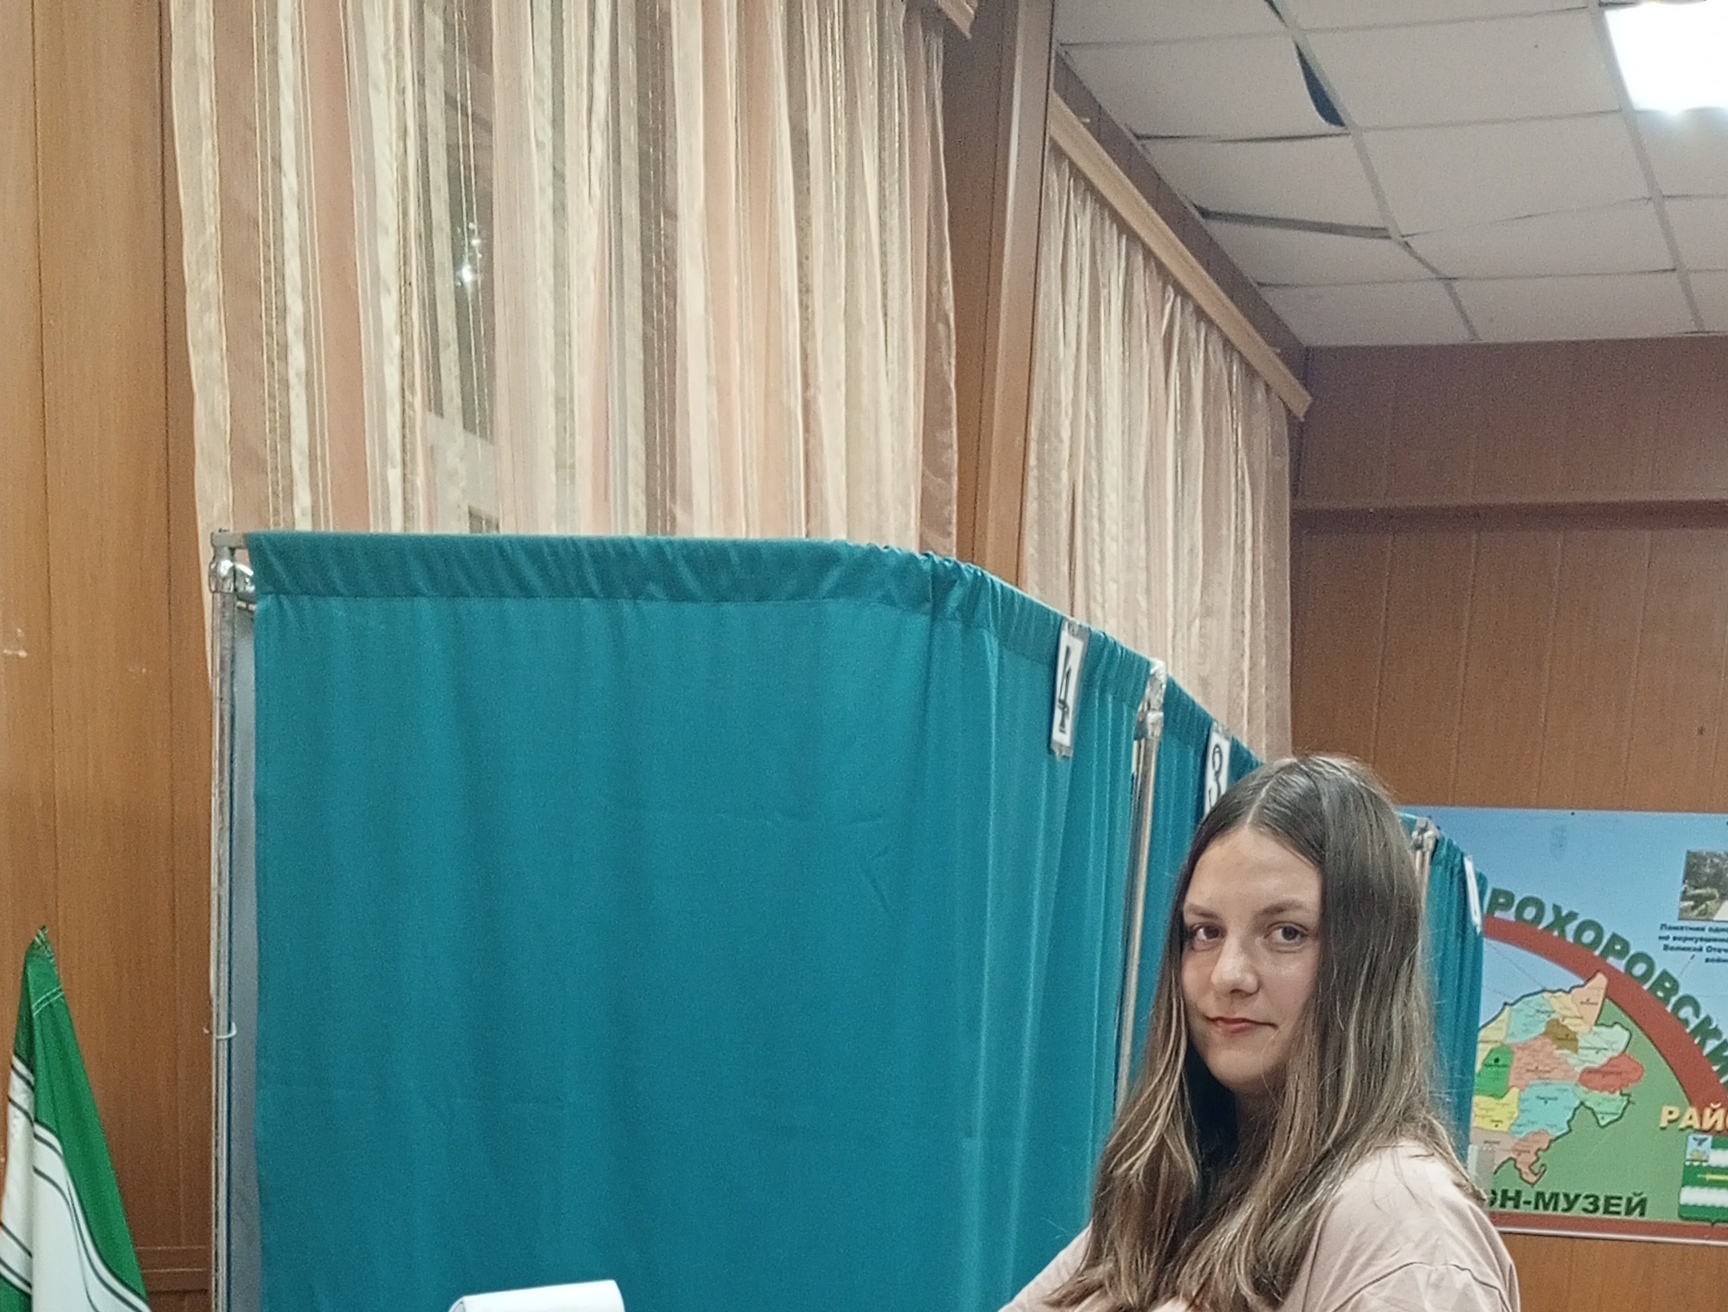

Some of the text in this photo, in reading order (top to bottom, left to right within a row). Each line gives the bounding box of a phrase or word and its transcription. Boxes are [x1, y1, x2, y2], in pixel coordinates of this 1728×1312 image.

[1057, 644, 1072, 736] 4
[1485, 887, 1728, 1090] РОХОРОВСКИ
[1659, 1102, 1728, 1132] РАЙ
[1489, 1188, 1648, 1217] Н-МУЗЕЙ
